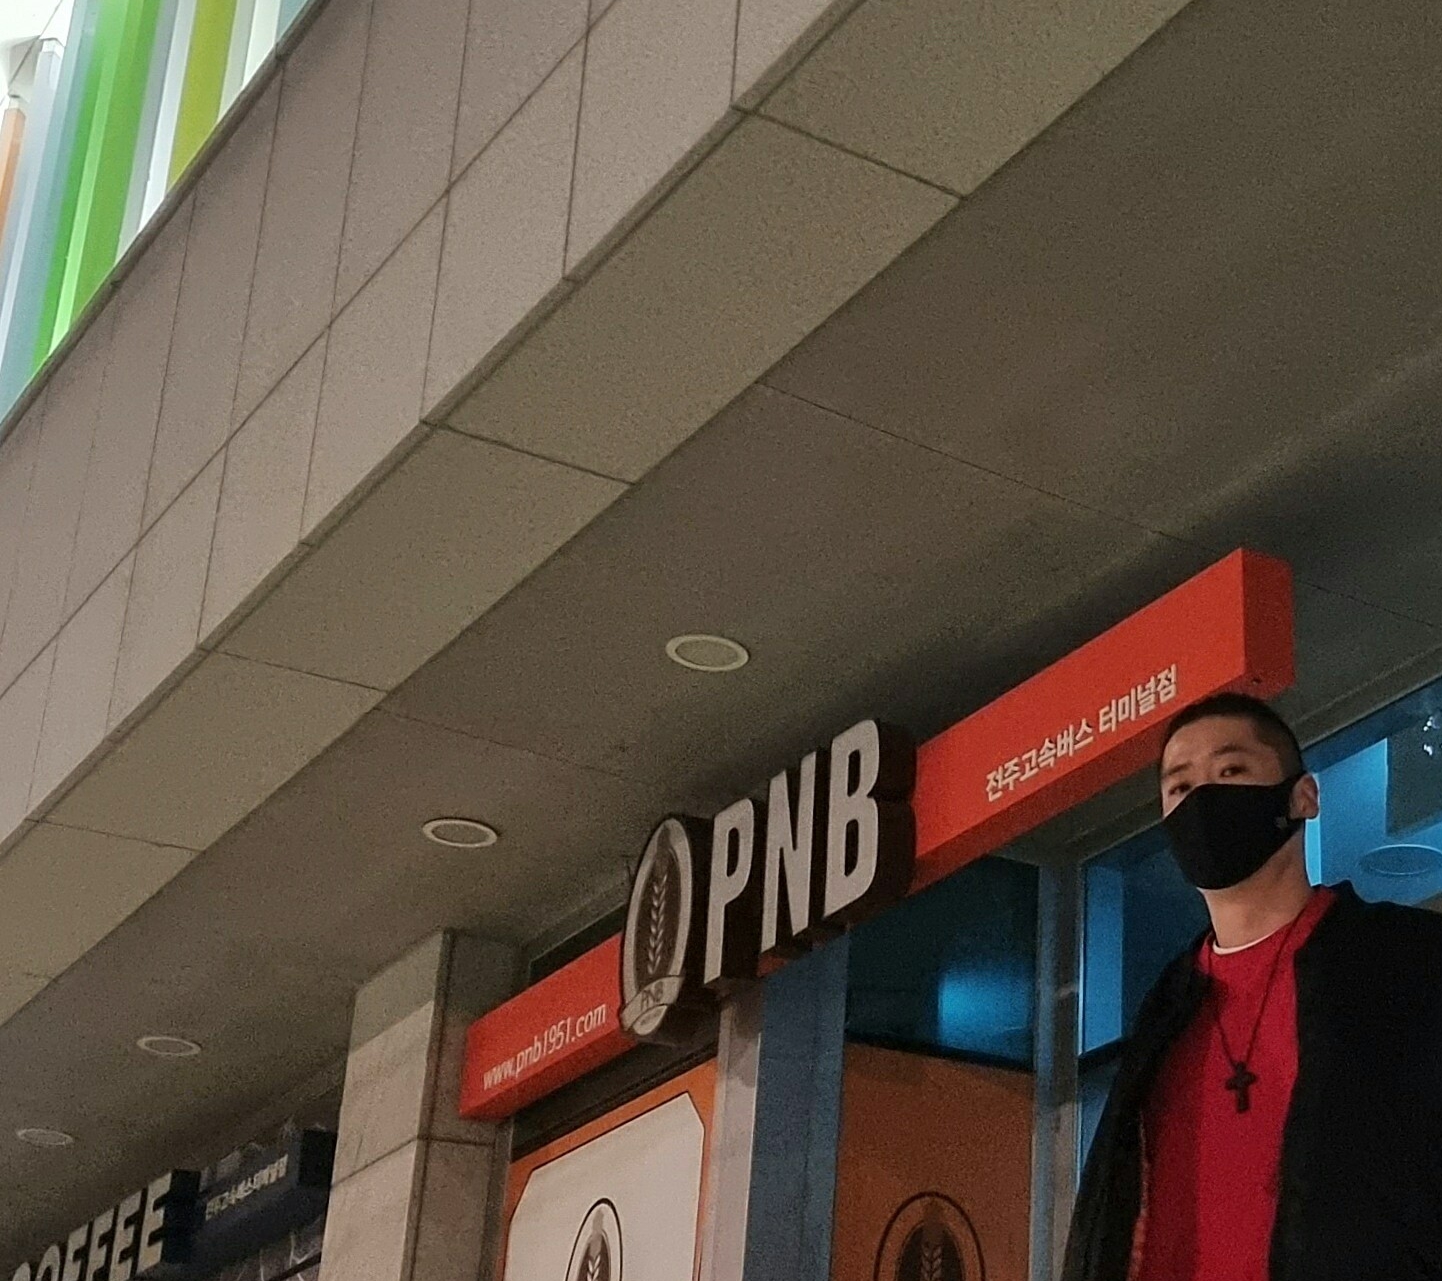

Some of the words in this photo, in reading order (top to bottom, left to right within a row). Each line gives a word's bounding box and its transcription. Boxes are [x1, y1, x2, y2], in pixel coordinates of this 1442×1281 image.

[985, 717, 1095, 803] 전주고속버스
[1098, 663, 1178, 734] 터미널점
[703, 719, 880, 985] PNB
[483, 1003, 606, 1091] www.pnb1951.com
